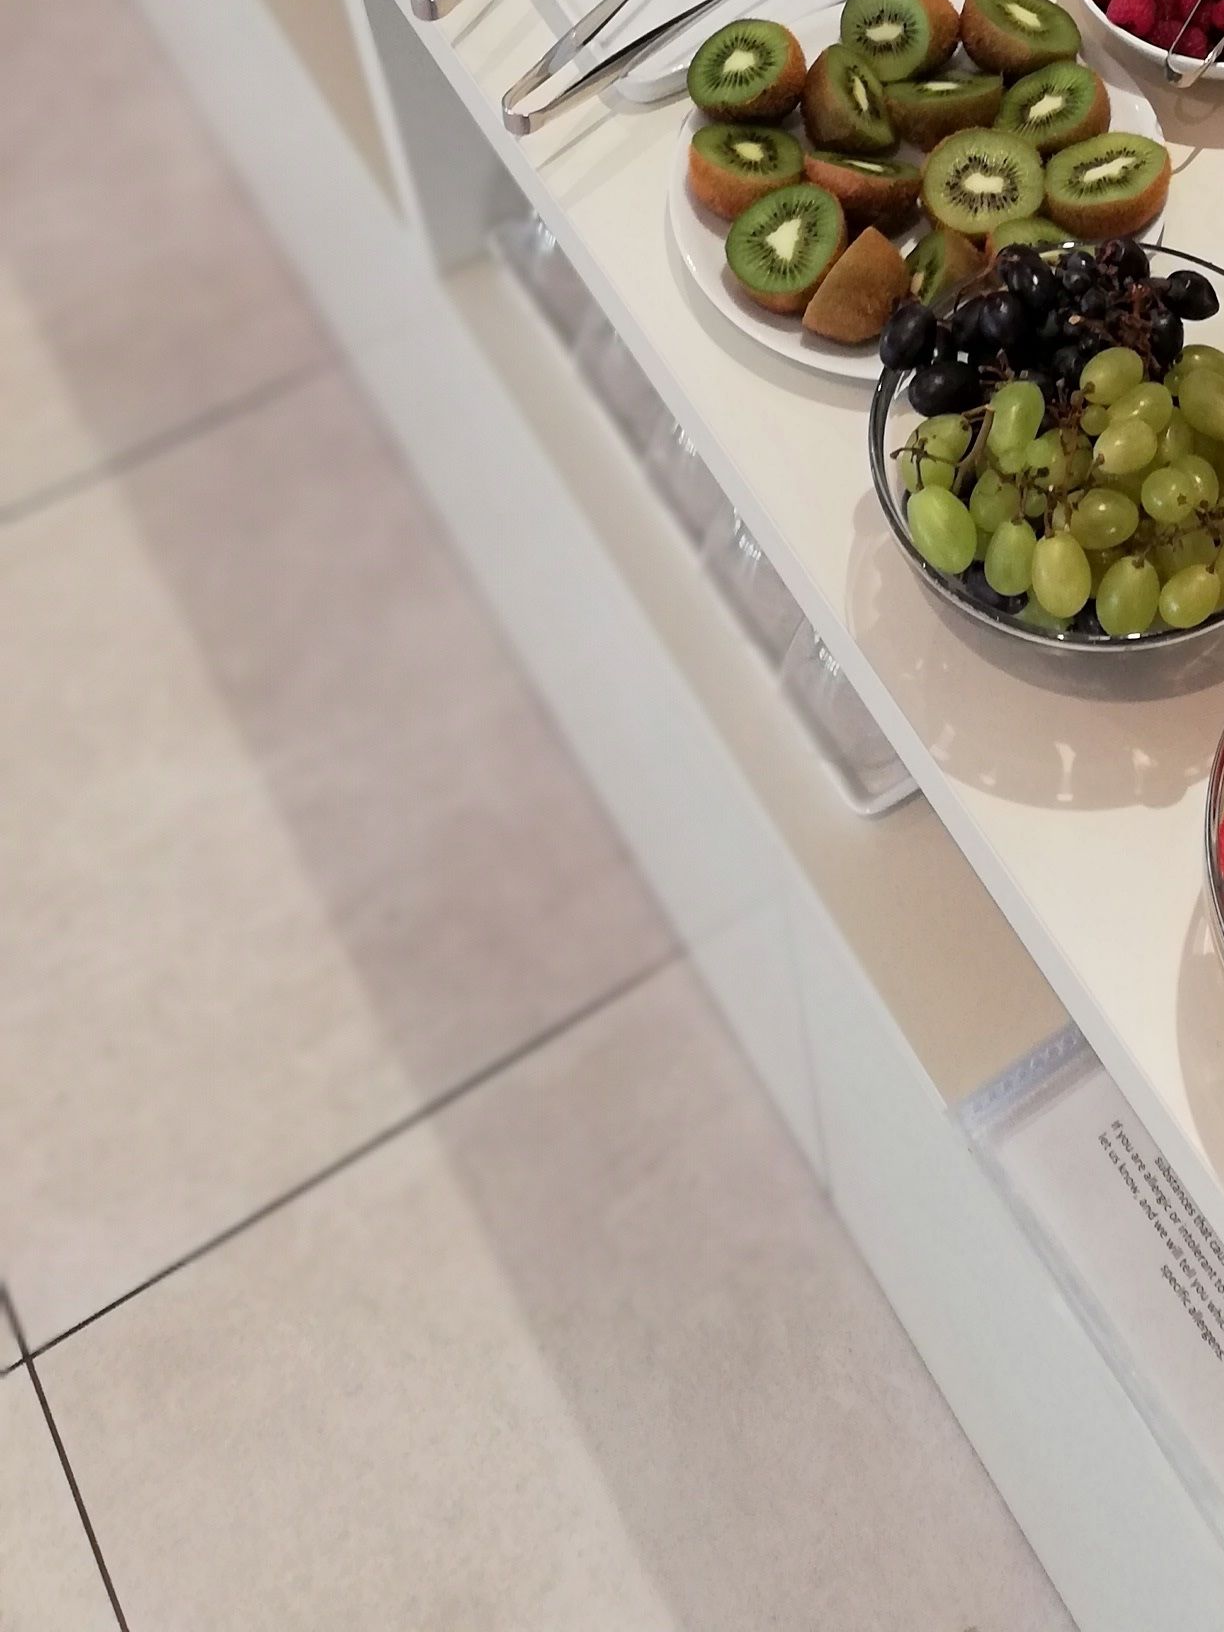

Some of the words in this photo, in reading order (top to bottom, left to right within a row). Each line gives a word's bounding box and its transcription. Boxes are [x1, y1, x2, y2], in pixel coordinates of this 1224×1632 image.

[1098, 1132, 1112, 1151] let
[1108, 1150, 1120, 1164] us
[1139, 1199, 1158, 1220] and
[1154, 1220, 1167, 1239] we
[1190, 1278, 1208, 1302] you
[1116, 1131, 1134, 1153] you
[1131, 1153, 1146, 1171] are
[1144, 1172, 1171, 1212] allergic
[1169, 1212, 1181, 1224] or
[1178, 1223, 1217, 1281] intolerant
[1214, 1278, 1224, 1294] to
[1155, 1156, 1196, 1217] substances
[1194, 1215, 1212, 1241] that
